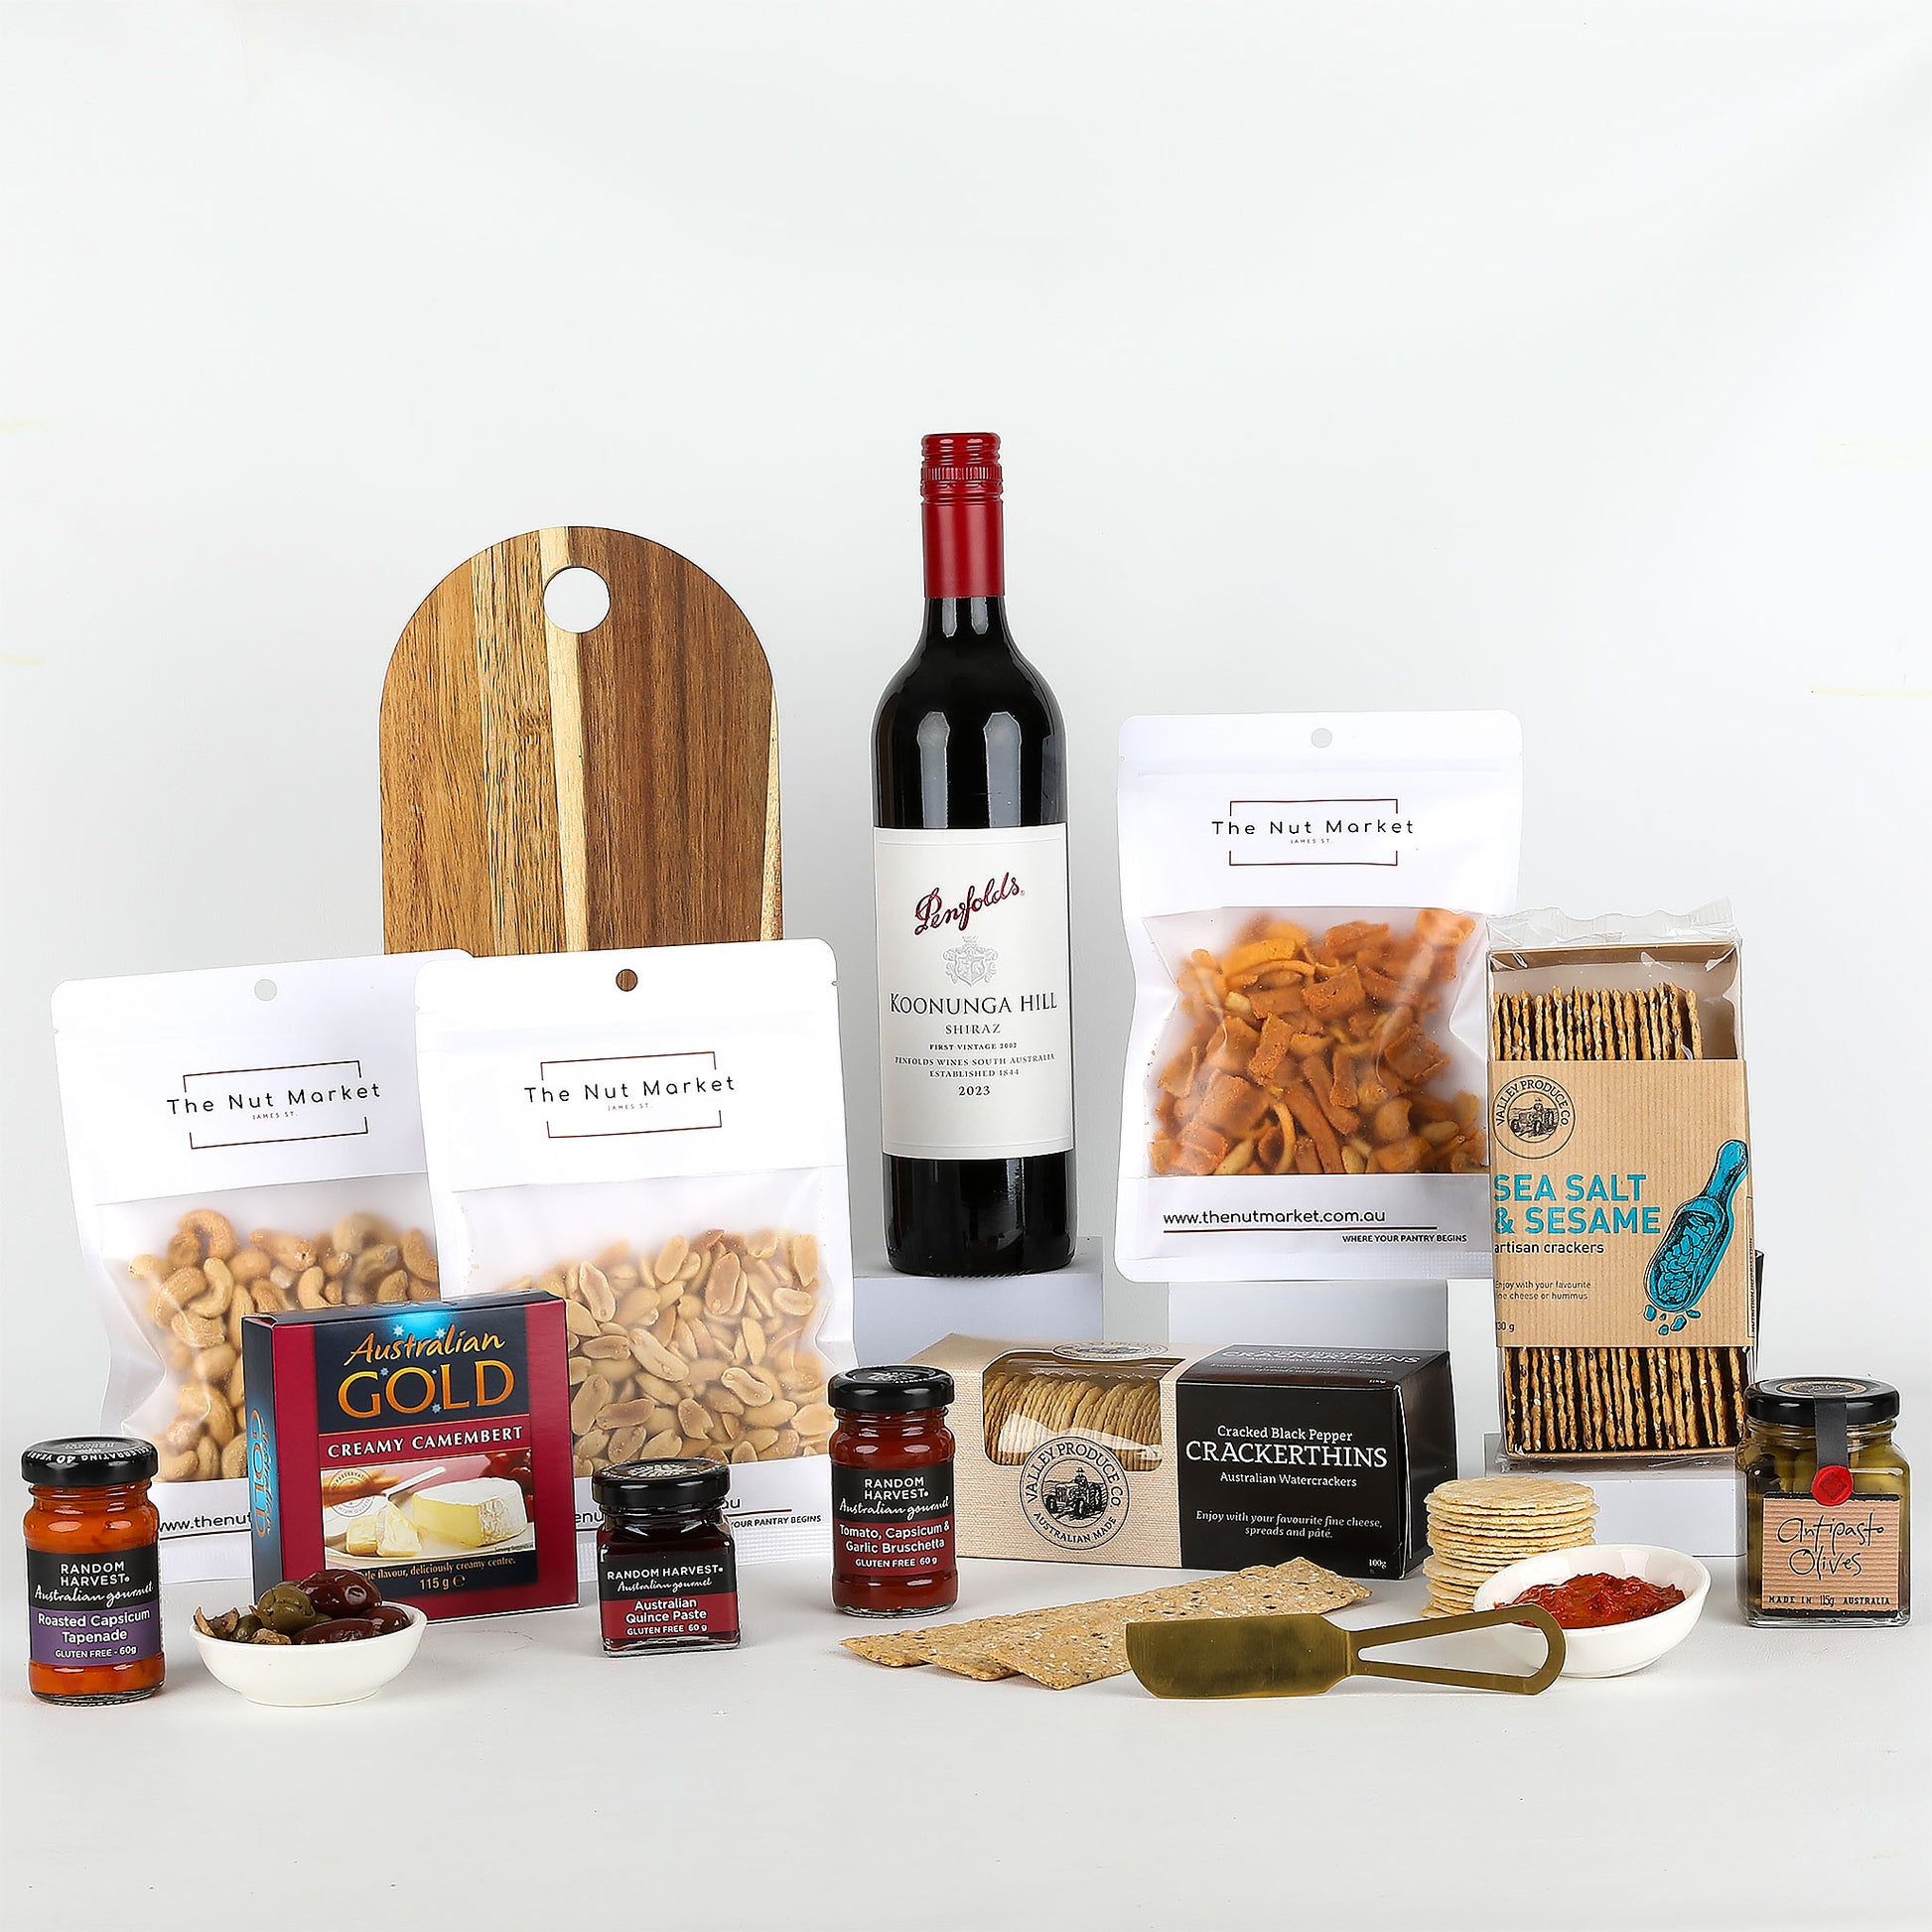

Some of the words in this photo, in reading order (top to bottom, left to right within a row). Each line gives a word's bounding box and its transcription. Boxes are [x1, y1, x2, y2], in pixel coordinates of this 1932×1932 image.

[1211, 821, 1256, 835] The
[1270, 821, 1312, 835] Nut
[1325, 819, 1414, 834] Market
[913, 872, 1021, 935] Penfolds
[890, 993, 1012, 1016] KOONUNGA
[1021, 992, 1058, 1012] HILL
[945, 1024, 1002, 1035] SHIRAZ
[971, 1057, 1007, 1066] SOUTH
[1010, 1053, 1055, 1064] AUSTRALIA
[929, 1069, 996, 1078] ESTABLISHED
[523, 1086, 570, 1103] The
[584, 1083, 629, 1101] Nut
[642, 1075, 736, 1096] Market
[958, 1086, 991, 1096] 2023
[166, 1098, 214, 1115] The
[228, 1093, 274, 1110] Nut
[287, 1082, 381, 1106] Market
[1495, 1083, 1519, 1127] VALLEY
[1520, 1079, 1569, 1109] PRODUCE
[252, 1112, 281, 1121] JAMES
[1494, 1173, 1557, 1201] SEA
[1566, 1173, 1647, 1201] SALT
[1163, 1209, 1386, 1225] www.thenutmarket.com.au
[1494, 1206, 1515, 1234] &
[1525, 1206, 1661, 1234] SESAME
[1342, 1234, 1374, 1243] WHERE
[1374, 1234, 1400, 1243] YOUR
[1401, 1234, 1436, 1243] PANTRY
[1436, 1234, 1467, 1243] BEGINS
[1494, 1241, 1539, 1254] artisan
[1544, 1241, 1604, 1254] crackers
[1509, 1323, 1515, 1333] g
[343, 1324, 505, 1367] Australian
[338, 1359, 516, 1420] GOLD
[327, 1438, 404, 1458] CREAMY
[411, 1427, 524, 1450] CAMEMBERT
[1217, 1425, 1269, 1439] Cracked
[1271, 1427, 1307, 1441] Black
[1309, 1429, 1353, 1444] Pepper
[56, 1454, 76, 1464] 40
[1185, 1441, 1388, 1468] CRACKERTHINS
[250, 1408, 267, 1539] GOLD
[1026, 1447, 1055, 1503] VALLEY
[1056, 1442, 1120, 1483] PRODUCE
[1220, 1471, 1277, 1484] Australian
[1279, 1473, 1358, 1487] Watercrackers
[865, 1476, 925, 1489] RANDOM
[865, 1489, 925, 1501] HARVEST
[839, 1498, 905, 1515] Australian
[755, 1517, 789, 1526] PANTRY
[791, 1515, 822, 1524] BEGINS
[1034, 1512, 1091, 1543] AUSTRALIAN
[1092, 1516, 1117, 1541] MADE
[1195, 1510, 1224, 1523] Enjoy
[1226, 1511, 1249, 1522] with
[1250, 1515, 1275, 1525] your
[1275, 1513, 1323, 1526] favourite
[1323, 1515, 1345, 1528] fine
[1346, 1517, 1383, 1530] cheese,
[839, 1523, 882, 1539] Tomato,
[885, 1524, 942, 1541] Capsicum
[943, 1521, 950, 1531] &
[1244, 1526, 1285, 1538] spreads
[1286, 1527, 1306, 1538] and
[1308, 1528, 1333, 1540] pâté.
[845, 1541, 879, 1554] Garlic
[882, 1538, 945, 1555] Bruschetta
[61, 1562, 125, 1575] RANDOM
[377, 1568, 409, 1580] flavour,
[410, 1562, 454, 1577] deliciously
[456, 1560, 485, 1572] creamy
[487, 1557, 516, 1568] centre.
[855, 1558, 890, 1568] GLUTEN
[892, 1558, 915, 1568] FREE
[919, 1557, 930, 1566] 60
[1369, 1559, 1387, 1569] 100g
[1788, 1545, 1863, 1581] Olives
[61, 1574, 126, 1587] HARVEST
[607, 1569, 659, 1581] RANDOM
[662, 1565, 719, 1577] HARVEST
[420, 1577, 440, 1590] 115
[442, 1578, 450, 1590] g
[617, 1580, 671, 1592] Australian
[34, 1585, 104, 1602] Australian
[1768, 1595, 1795, 1604] MADE
[1801, 1595, 1812, 1604] IN
[1843, 1596, 1891, 1605] AUSTRALIA
[633, 1598, 697, 1611] Australian
[38, 1613, 87, 1628] Roasted
[90, 1609, 150, 1628] Capsicum
[625, 1612, 670, 1624] Quince
[673, 1609, 707, 1621] Paste
[62, 1630, 128, 1645] Tapenade
[626, 1626, 661, 1636] GLUTEN
[55, 1649, 87, 1658] GLUTEN
[89, 1648, 112, 1657] FREE
[119, 1646, 137, 1656] 60g
